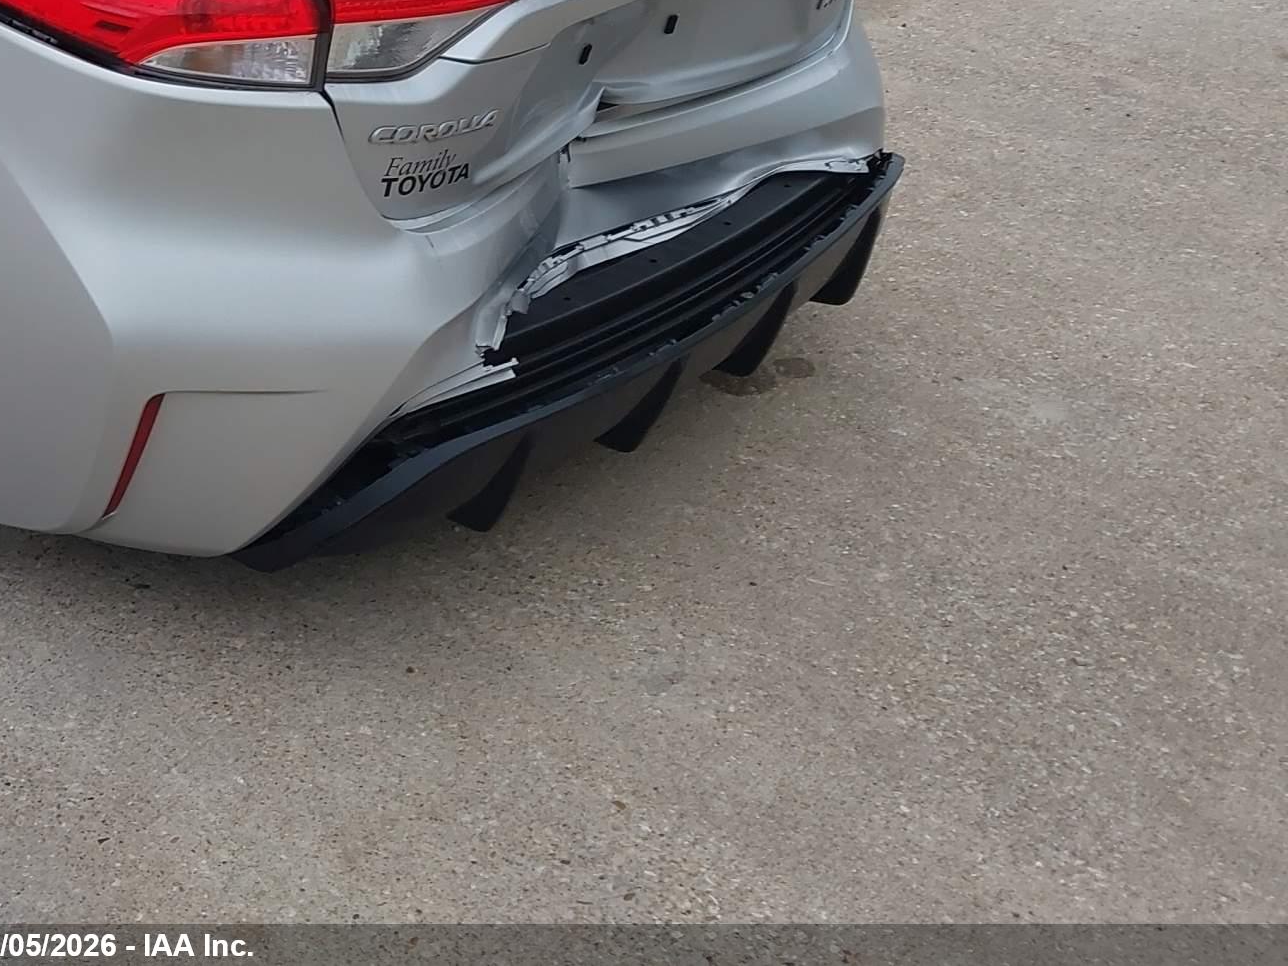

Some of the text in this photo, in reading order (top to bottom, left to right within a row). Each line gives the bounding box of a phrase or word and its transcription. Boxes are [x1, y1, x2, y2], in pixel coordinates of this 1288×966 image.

[368, 108, 501, 144] COROLLA
[383, 148, 457, 177] Family
[381, 163, 470, 197] TOYOTA
